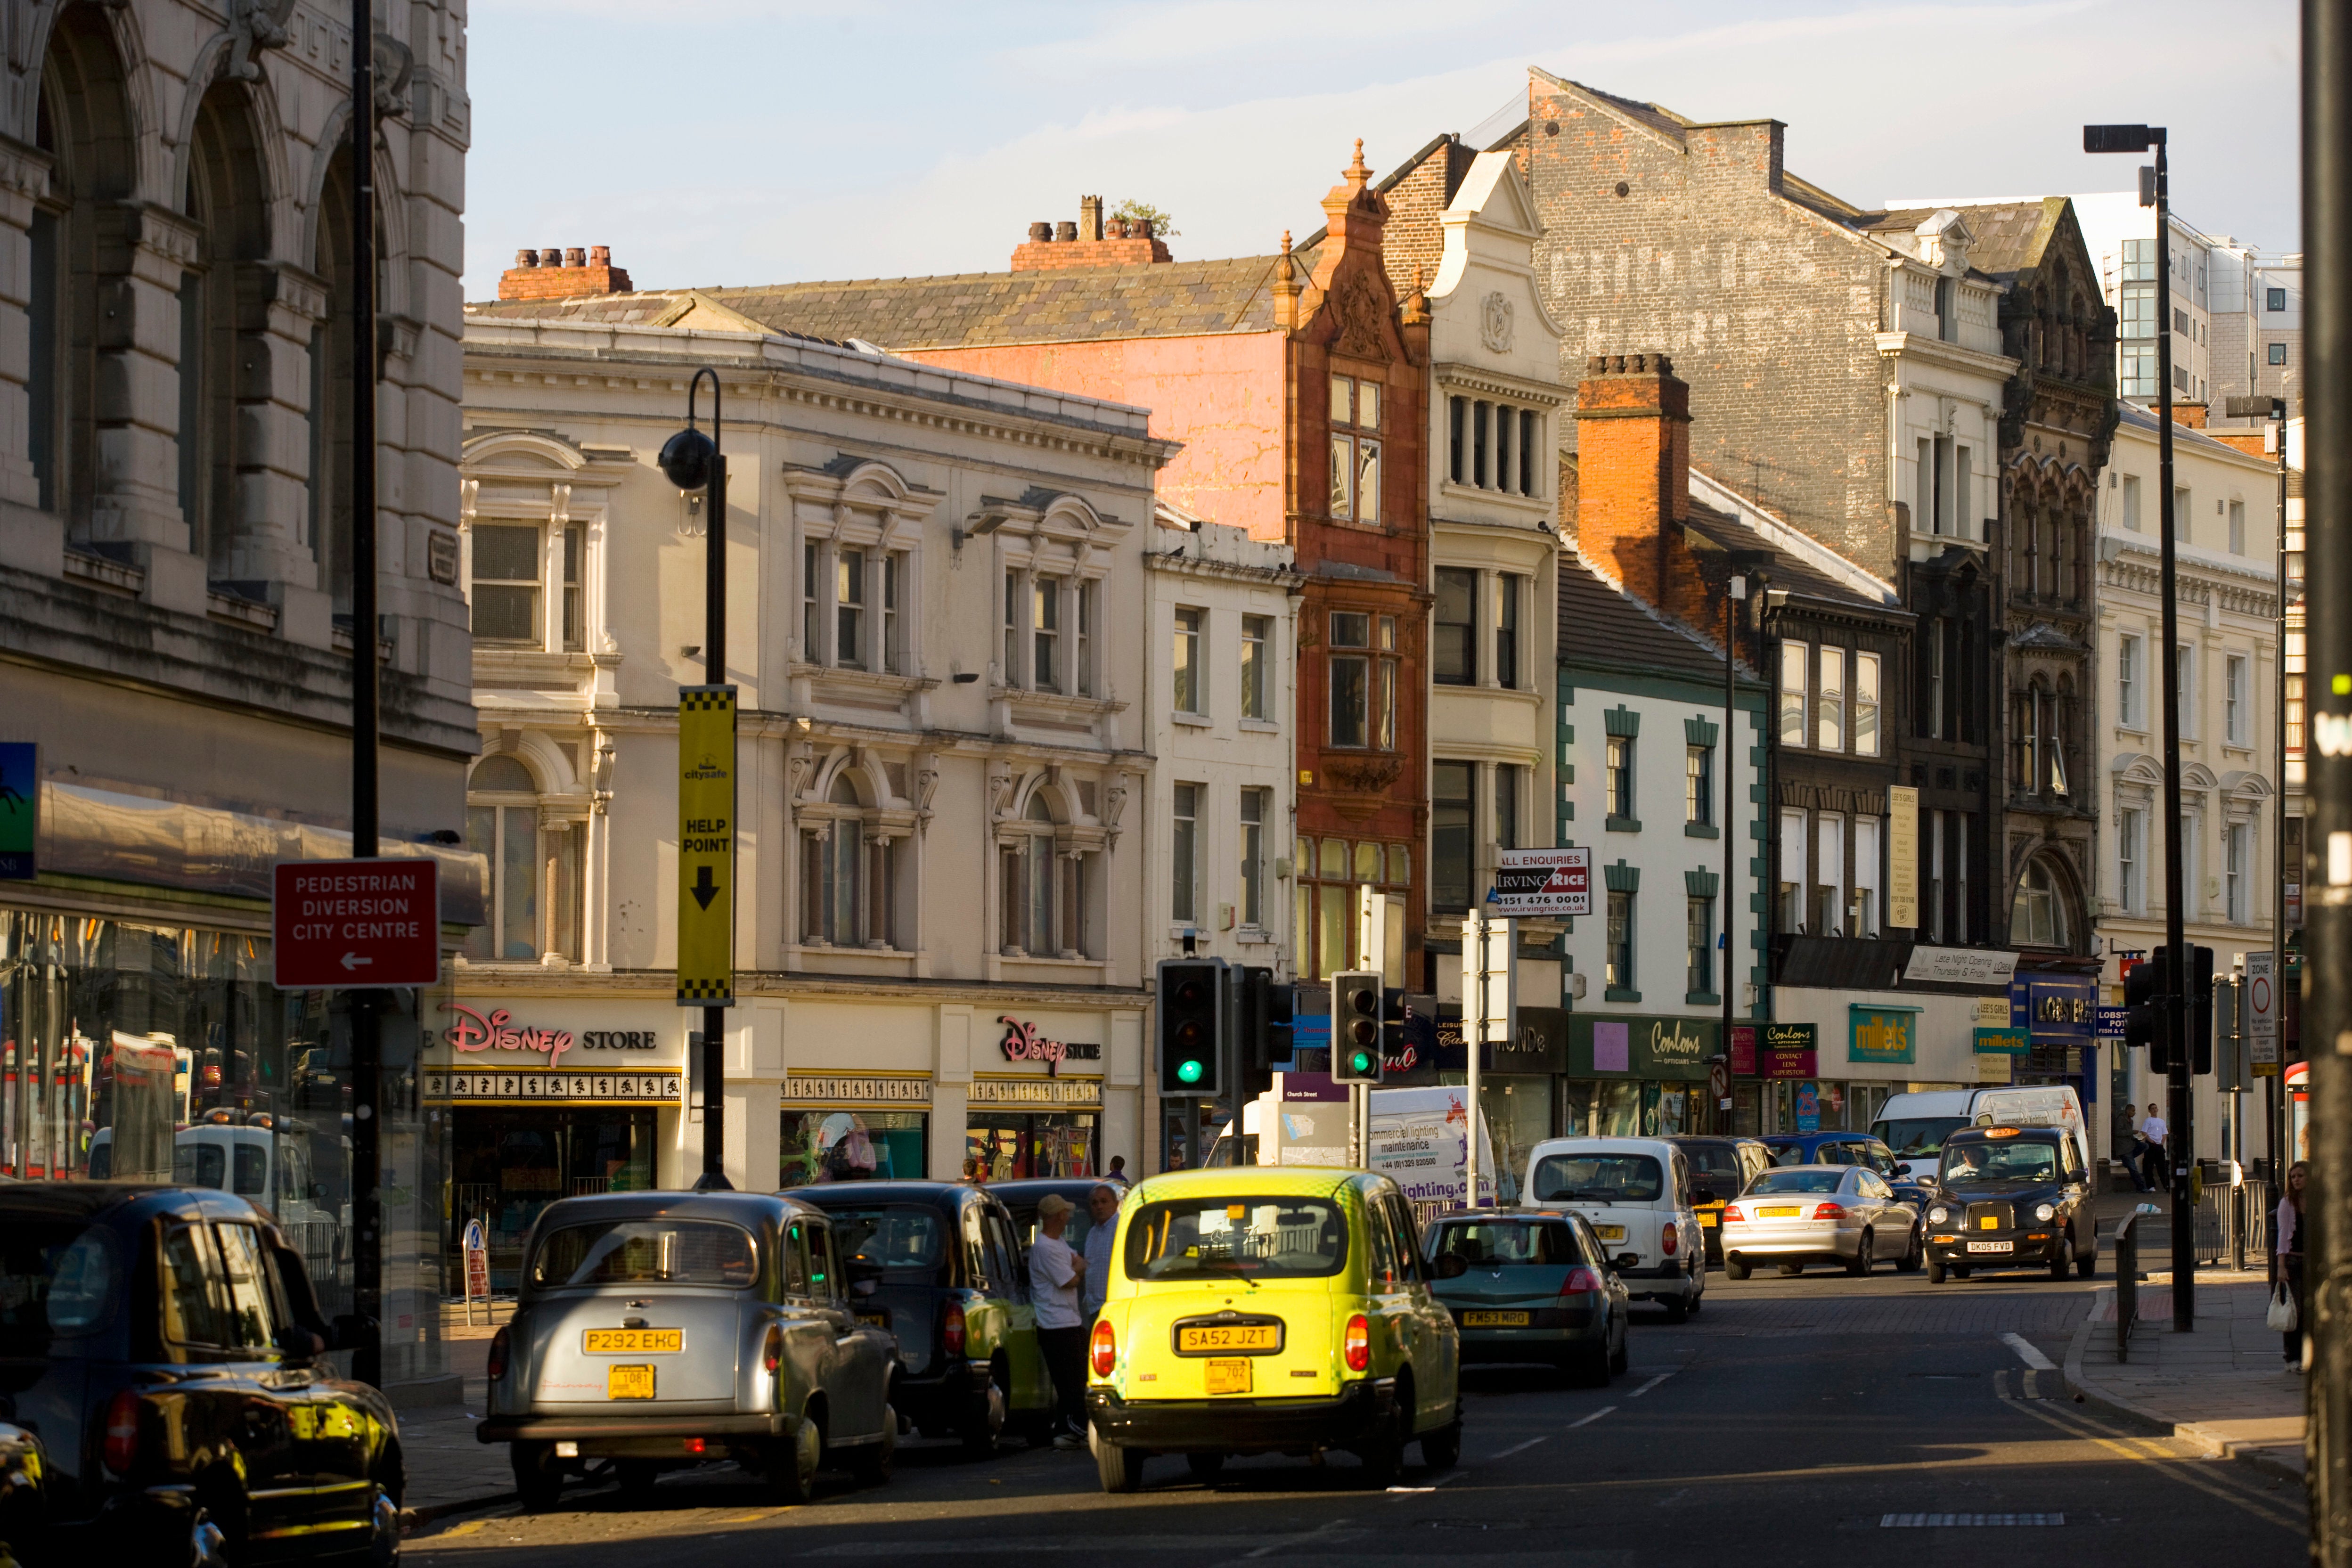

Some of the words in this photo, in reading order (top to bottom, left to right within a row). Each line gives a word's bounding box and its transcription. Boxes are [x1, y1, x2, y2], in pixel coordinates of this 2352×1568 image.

[685, 770, 727, 780] citysafe
[1892, 793, 1902, 801] LEE'S
[1903, 794, 1915, 802] GIRLS
[687, 819, 726, 833] HELP
[684, 838, 729, 852] POINT
[1523, 856, 1581, 866] ENQUIRIES
[296, 874, 416, 893] PEDESTRIAN
[1496, 874, 1546, 887] IRVING
[1552, 873, 1585, 886] RICE
[302, 898, 409, 916] DIVERSION
[1497, 897, 1521, 905] 0151
[1527, 896, 1551, 904] 476
[1556, 895, 1585, 903] 0001
[1496, 904, 1584, 914] www.irvingrice.co.uk
[293, 923, 334, 940] CITY
[342, 922, 419, 939] CENTRE
[1935, 953, 1950, 964] Late
[1951, 955, 1968, 965] Night
[1968, 956, 1992, 967] Opening
[1933, 966, 1961, 977] Thursday
[1962, 967, 1968, 976] &
[1969, 968, 1988, 979] Friday
[2252, 964, 2269, 974] ZONE
[1981, 1004, 1993, 1013] LEE'S
[1994, 1004, 2008, 1014] GIRLS
[583, 1031, 657, 1049] STORE
[1651, 1020, 1700, 1054] Conlons
[1767, 1026, 1811, 1040] Conlons
[1856, 1016, 1907, 1051] millets
[1979, 1034, 2025, 1047] millets
[1066, 1043, 1101, 1060] STORE
[1370, 1127, 1409, 1141] ommercial
[1410, 1125, 1439, 1140] lighting
[1381, 1140, 1429, 1153] maintenance
[1381, 1161, 1393, 1169] +44
[1416, 1158, 1436, 1166] 820500
[1400, 1180, 1489, 1200] ighting.cm
[1469, 1313, 1498, 1323] FM53
[589, 1334, 637, 1348] P292
[643, 1333, 678, 1348] EHC
[1188, 1330, 1230, 1346] SA52
[1237, 1329, 1267, 1344] JZT
[623, 1373, 648, 1383] 1081
[1226, 1367, 1245, 1377] 702
